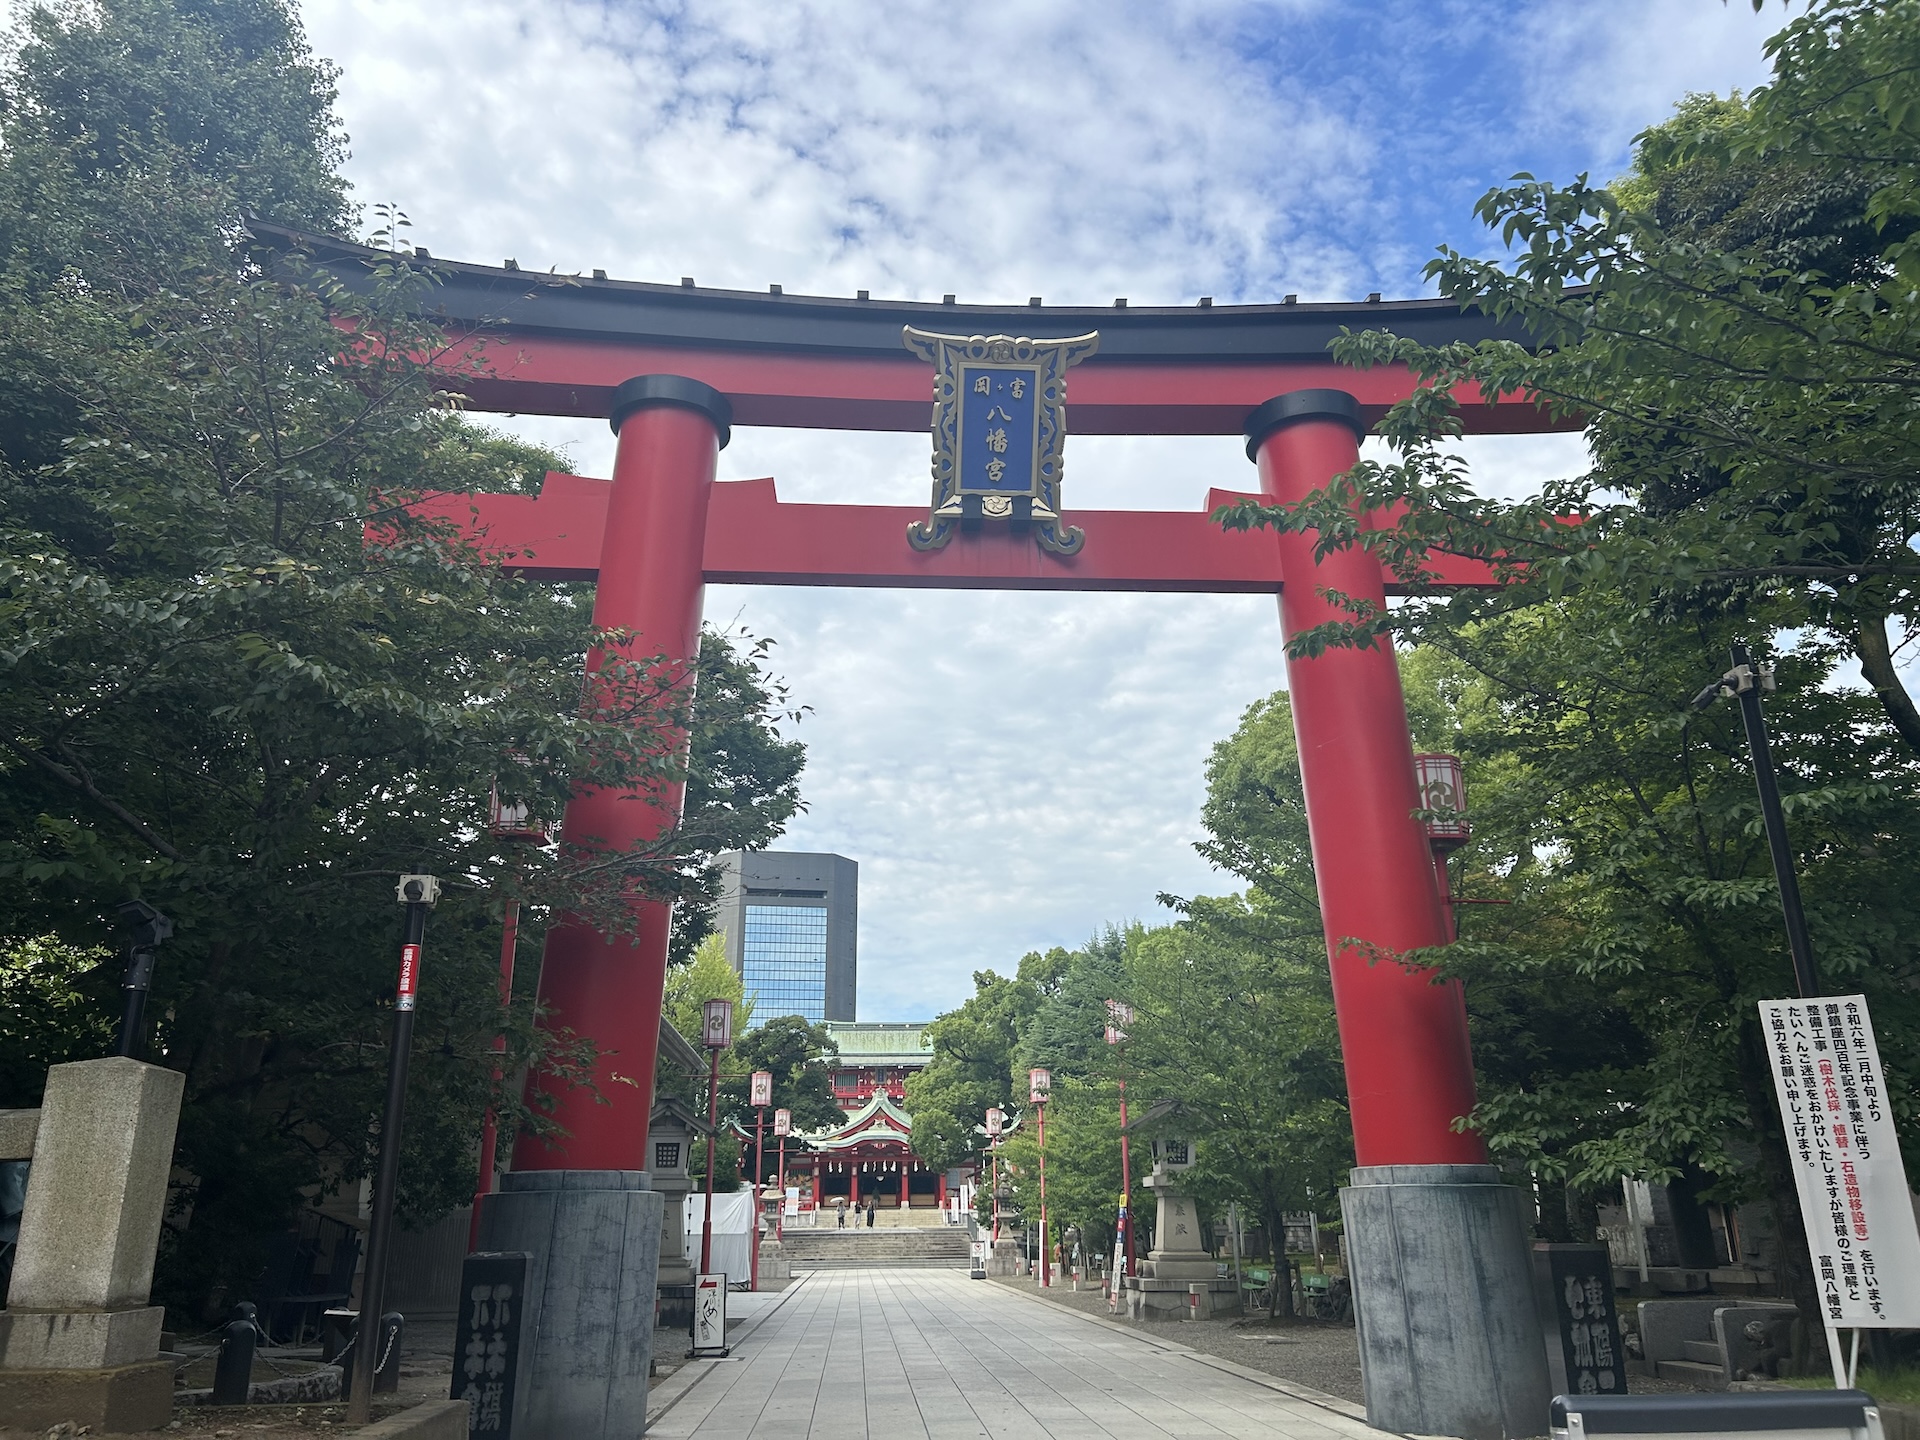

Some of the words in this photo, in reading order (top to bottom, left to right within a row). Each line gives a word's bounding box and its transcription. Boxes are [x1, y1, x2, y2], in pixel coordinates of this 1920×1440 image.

[1770, 1007, 1815, 1168] ご協力をお願い申し上げます。
[1825, 1003, 1871, 1160] 御鎮座四百年記念事業に伴う
[1844, 1001, 1881, 1122] 令和六年二月中旬より
[1788, 1006, 1861, 1301] たいへんご迷惑をおかけいたしますが皆様のご理解と
[1818, 1254, 1843, 1320] 富岡八幡宮
